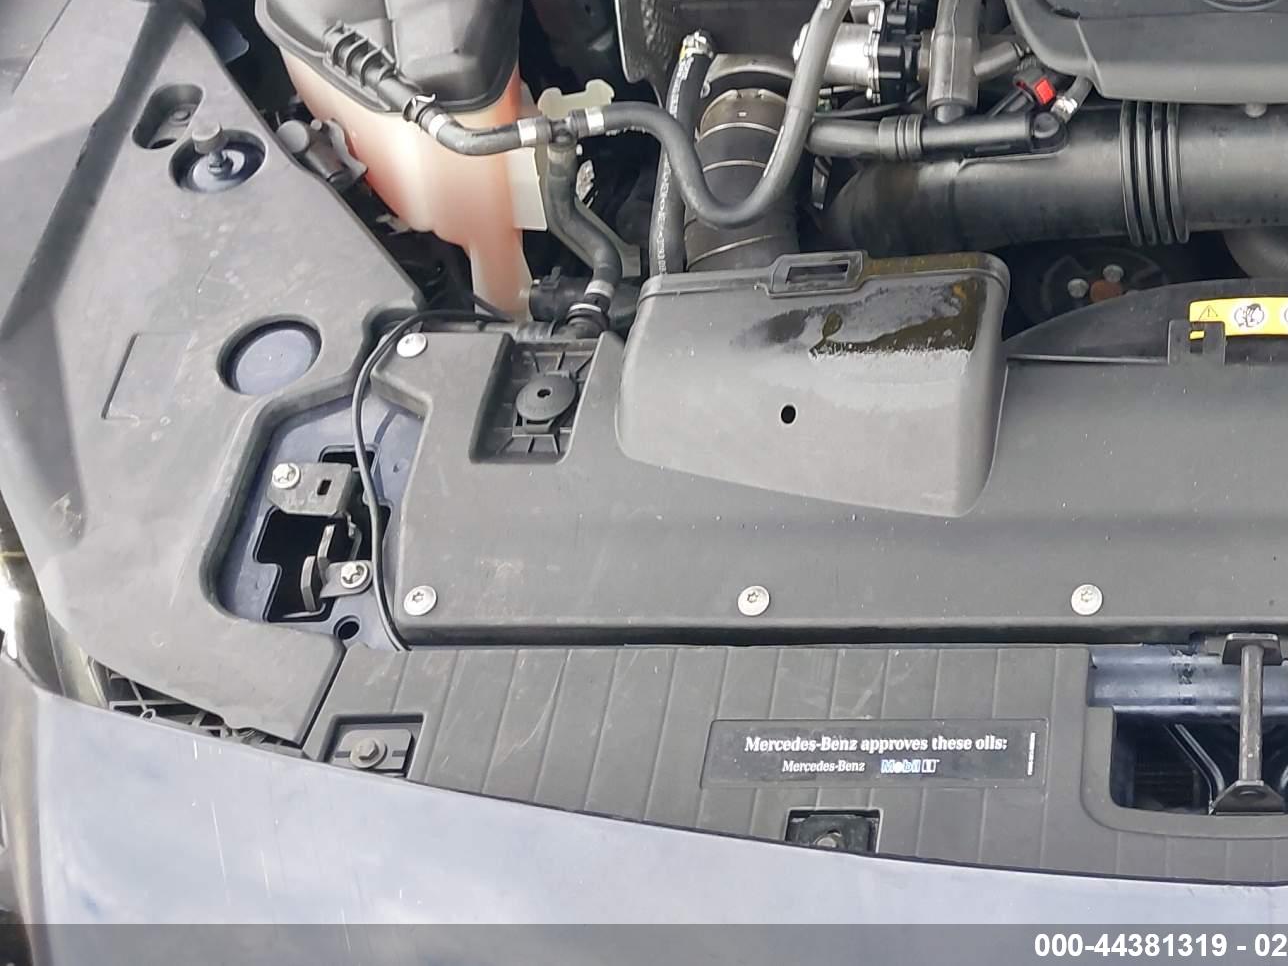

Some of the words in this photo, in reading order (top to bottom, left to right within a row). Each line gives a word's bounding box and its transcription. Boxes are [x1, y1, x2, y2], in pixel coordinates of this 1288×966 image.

[745, 736, 858, 752] Mercedes-Benz
[860, 738, 928, 754] approves
[932, 735, 972, 751] these
[975, 735, 1009, 751] oils:
[782, 759, 866, 773] Mercedes-Benz
[880, 759, 921, 774] Mobil
